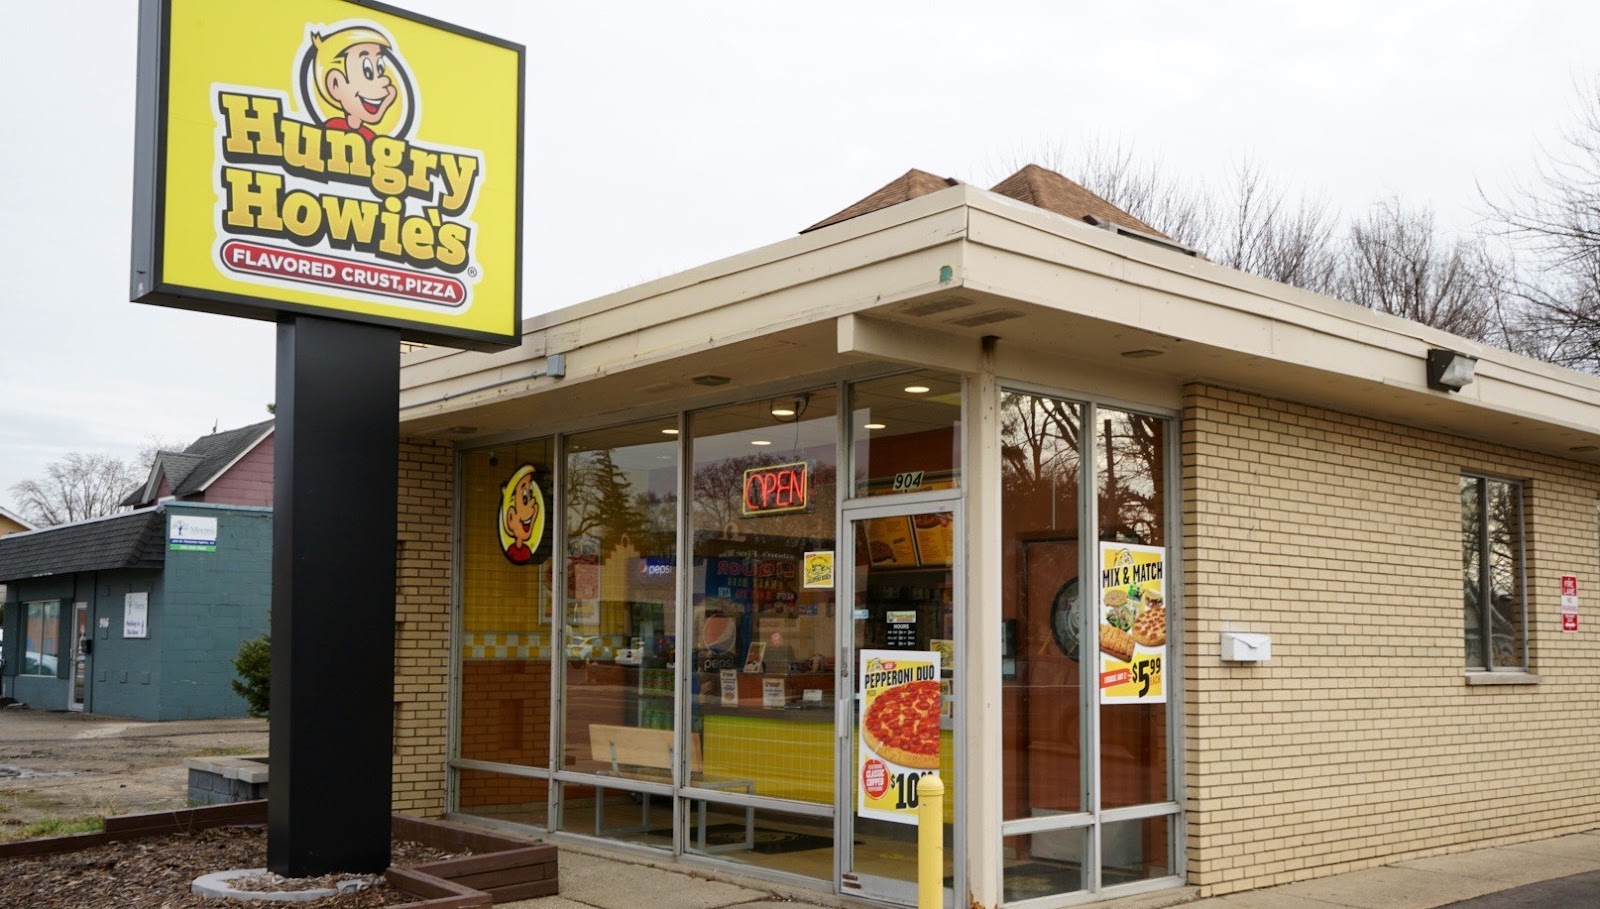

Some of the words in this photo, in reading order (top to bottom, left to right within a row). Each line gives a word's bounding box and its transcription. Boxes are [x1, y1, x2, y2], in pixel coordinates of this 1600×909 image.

[219, 91, 479, 214] Hungry
[221, 166, 471, 272] Howie's
[232, 247, 336, 279] FLAVORED
[405, 279, 457, 299] PIZZA
[746, 470, 804, 508] OPEN
[895, 472, 922, 489] 904
[1102, 567, 1120, 588] MIX
[1123, 566, 1130, 585] &
[1133, 561, 1163, 583] MATCH
[864, 667, 913, 690] PEPPERONI
[917, 665, 935, 680] DUO
